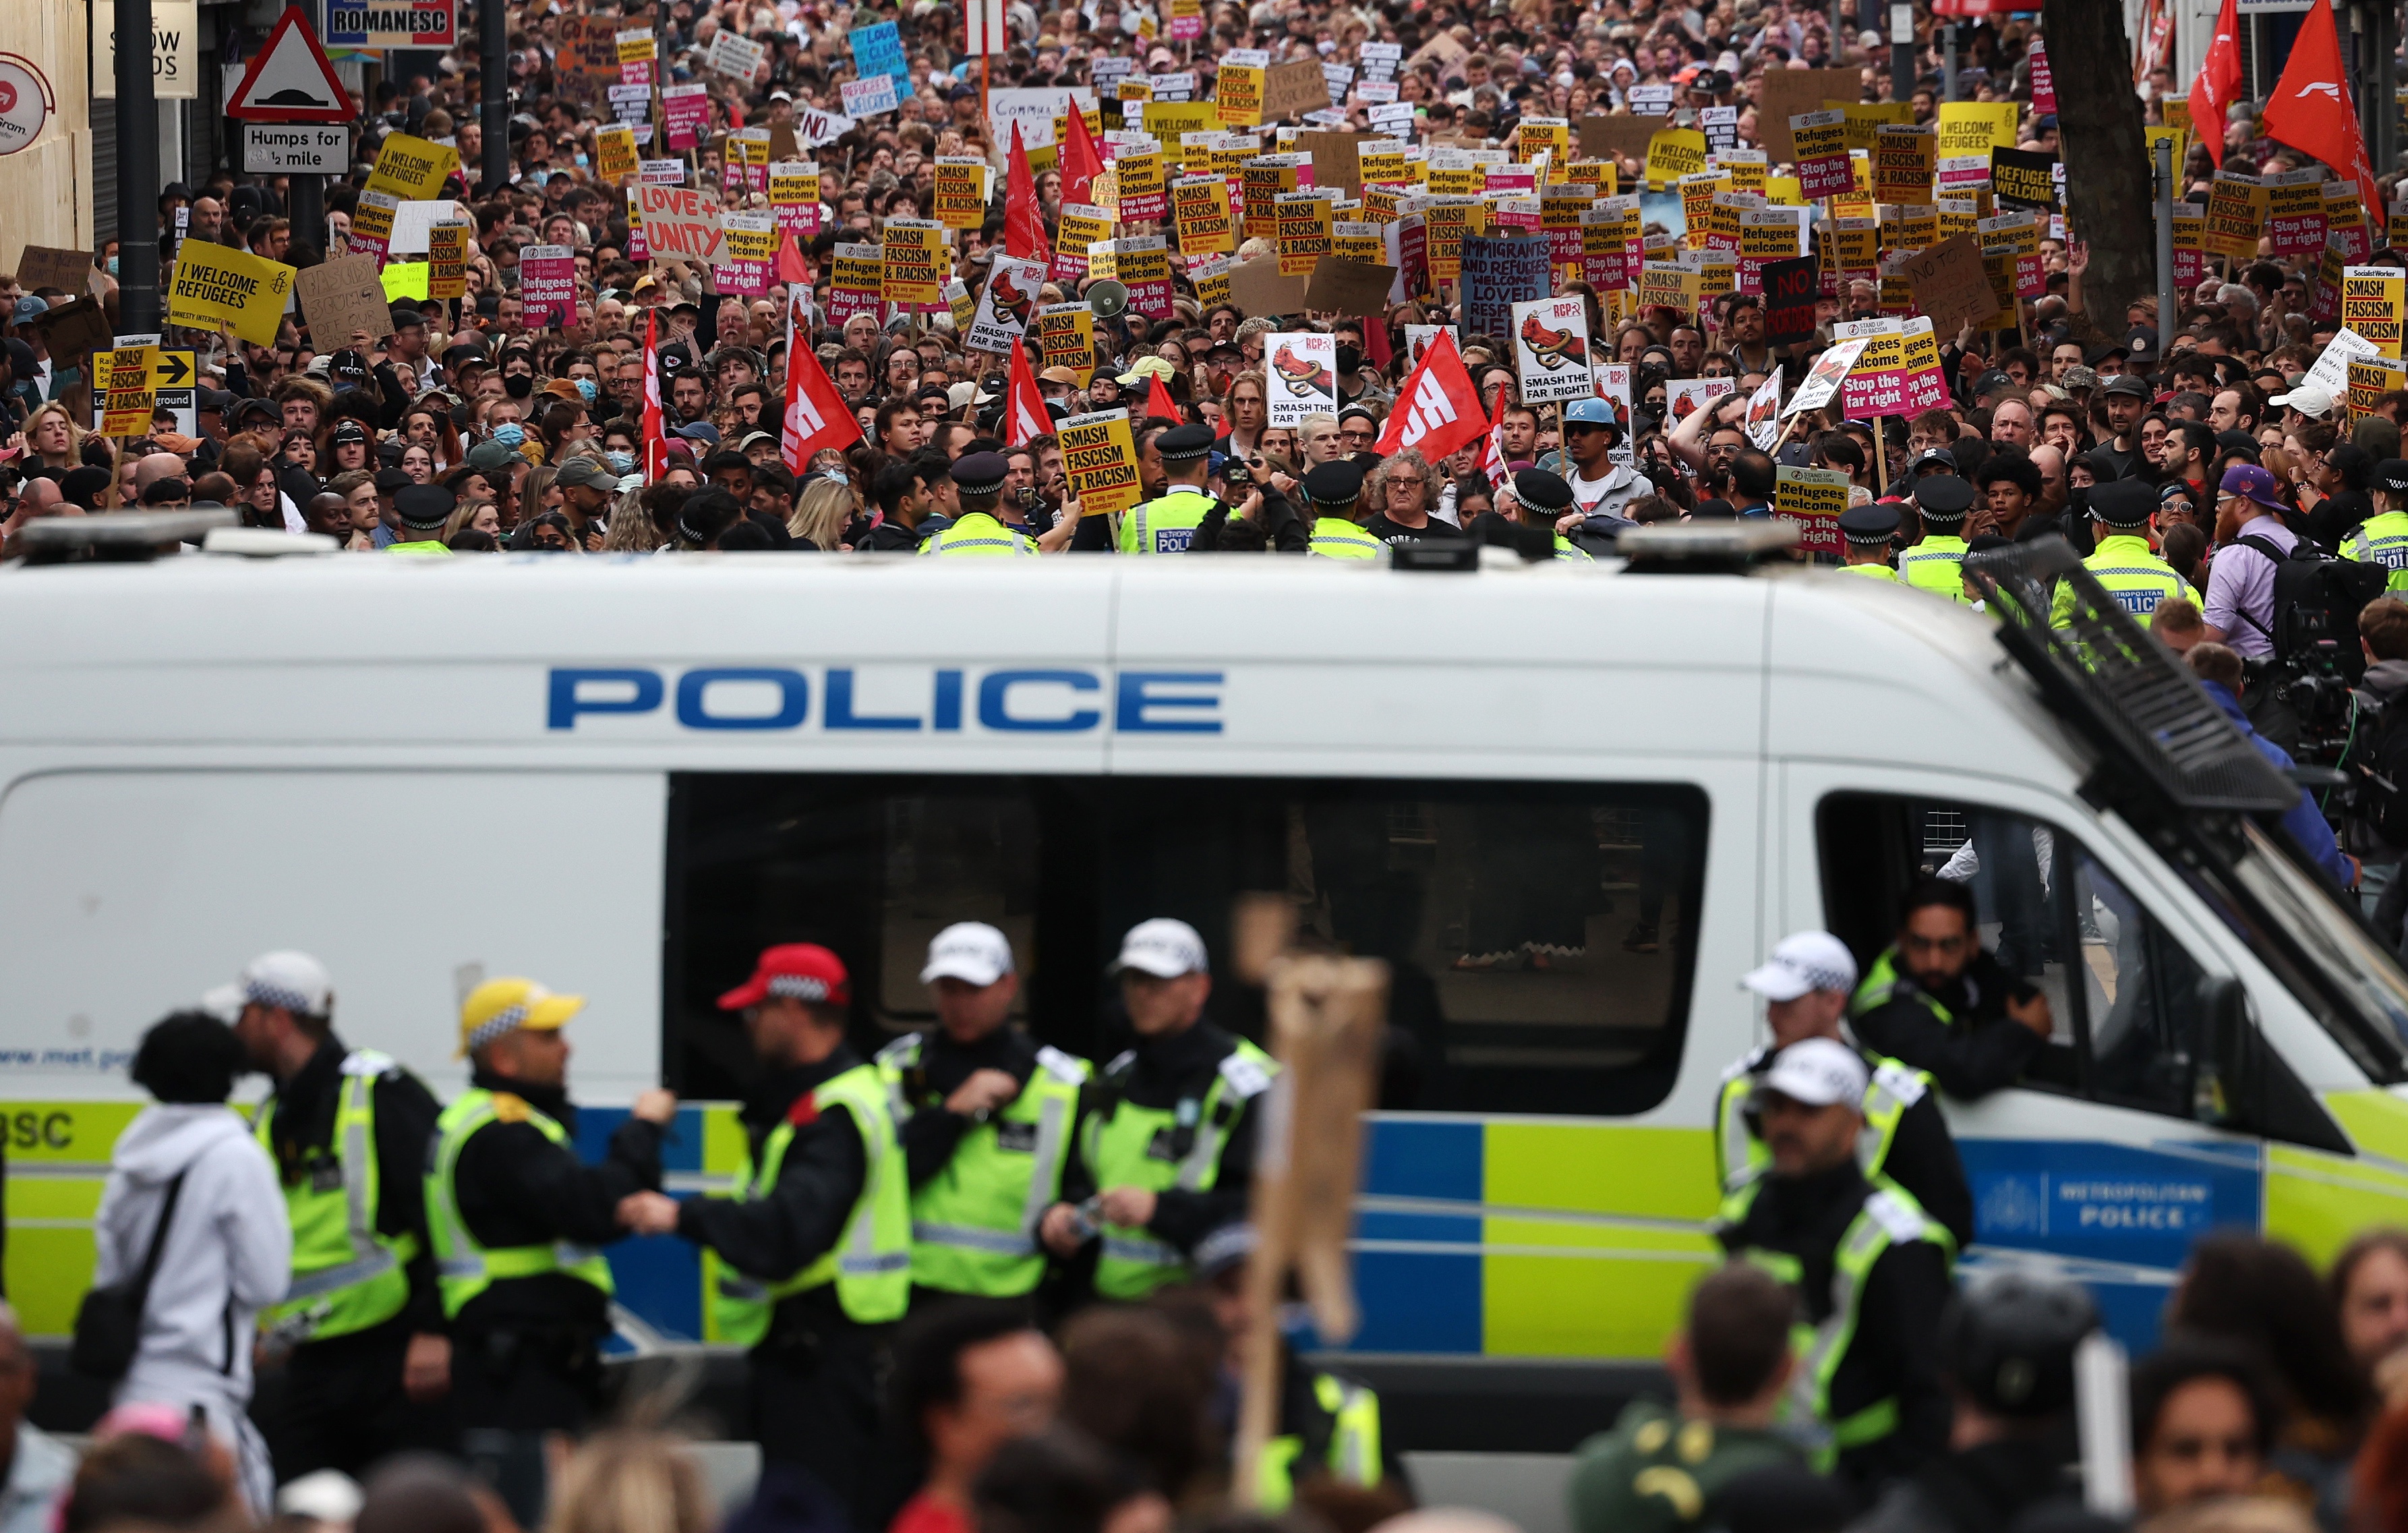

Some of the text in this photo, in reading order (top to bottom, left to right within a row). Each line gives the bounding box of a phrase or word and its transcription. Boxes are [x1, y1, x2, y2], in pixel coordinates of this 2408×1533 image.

[334, 9, 446, 33] ROMANESC
[842, 76, 889, 96] REFUGEES
[846, 94, 895, 115] WELCOME
[802, 114, 829, 140] NO
[1945, 122, 1995, 134] WELCOME
[251, 131, 341, 146] Humps for
[1795, 127, 1844, 143] Refugees
[1941, 136, 1989, 148] REFUGEES
[1798, 140, 1836, 156] welcome
[1879, 137, 1916, 150] SMASH
[287, 152, 322, 165] mile
[390, 152, 434, 173] WELCOME
[1118, 158, 1153, 171] Oppose
[1879, 154, 1925, 167] FASCISM
[377, 163, 426, 186] REFUGEES
[937, 167, 970, 179] SMASH
[1800, 159, 1844, 175] Stop the
[1119, 170, 1153, 183] Tommy
[1802, 173, 1847, 189] far right
[1889, 171, 1931, 184] RACISM
[1996, 165, 2052, 185] REFUGEE
[773, 178, 817, 190] Refugees
[937, 182, 976, 194] FASCISM
[1120, 181, 1163, 196] Robinson
[1996, 182, 2052, 201] WELCOM
[2214, 183, 2250, 200] SMASH
[773, 190, 815, 200] welcome
[1177, 186, 1210, 201] SMASH
[2270, 187, 2320, 200] Refugees
[641, 186, 696, 217] LOVE
[946, 197, 982, 209] RACISM
[2272, 200, 2319, 213] welcome
[357, 205, 393, 223] Refugees
[1178, 202, 1221, 219] FASCISM
[1278, 204, 1314, 219] SMASH
[2211, 200, 2256, 219] FASCISM
[354, 219, 388, 235] welcome
[1063, 216, 1100, 231] Oppose
[1190, 219, 1229, 233] RACISM
[1279, 222, 1324, 236] FASCISM
[2220, 219, 2259, 235] RACISM
[2274, 219, 2320, 233] Stop the
[431, 230, 457, 243] SMASH
[647, 221, 726, 258] UNITY
[886, 231, 924, 245] SMASH
[1061, 229, 1097, 243] Tommy
[1584, 227, 1623, 239] Refugees
[1743, 227, 1796, 241] Refugees
[2276, 231, 2322, 245] far right
[430, 246, 462, 261] FASCISM
[1291, 238, 1331, 254] RACISM
[1463, 236, 1550, 258] IMMIGRANTS
[1744, 241, 1794, 253] welcome
[885, 249, 931, 263] FASCISM
[1117, 253, 1166, 266] Refugees
[438, 262, 465, 277] RACISM
[895, 266, 937, 281] RACISM
[1119, 266, 1164, 280] welcome
[1462, 258, 1549, 276] AND REFUGEES
[1912, 260, 1935, 278] NO
[190, 264, 259, 295] WELCOME
[523, 278, 572, 290] Refugees
[716, 274, 761, 288] far right
[1644, 273, 1682, 288] SMASH
[1778, 269, 1809, 295] NO
[176, 280, 247, 309] REFUGEES
[1473, 286, 1537, 301] LOVED
[2347, 280, 2384, 296] SMASH
[523, 291, 570, 301] welcome
[832, 291, 880, 304] Stop the
[523, 303, 548, 314] here
[831, 304, 847, 316] far
[1139, 297, 1166, 312] right
[2347, 301, 2393, 318] FASCISM
[171, 310, 236, 330] AMNESTY INTERNATNAL
[316, 310, 374, 335] OFF OUR
[1043, 316, 1074, 331] SMASH
[1766, 302, 1815, 335] BORDERS
[974, 325, 1003, 337] SMASH
[2357, 323, 2399, 339] RACISM
[970, 335, 989, 347] FAR
[1044, 333, 1084, 349] FASCISM
[2339, 332, 2370, 353] REFUGEES
[114, 349, 144, 367] SMASH
[1053, 351, 1092, 366] RACISM
[2330, 346, 2344, 357] ARE
[2320, 355, 2342, 372] HUMAN
[2355, 356, 2399, 369] Socialist Worker
[110, 371, 146, 388] FASCISM
[1525, 374, 1589, 388] SMASH THE
[2312, 366, 2338, 385] BEINGS
[2349, 371, 2386, 388] SMASH
[1527, 384, 1590, 398] FAR RIGHT!
[1844, 374, 1900, 393] Stop the
[107, 391, 152, 411] & RACISM
[1846, 391, 1902, 409] far right
[1273, 403, 1333, 413] SMASH THE
[1067, 413, 1117, 428] Socialist Worker
[1273, 413, 1294, 423] FAR
[1062, 426, 1110, 448] SMASH
[1067, 445, 1124, 469] FASCISM
[1609, 453, 1631, 462] RIGHT!
[1087, 465, 1137, 488] RACISM
[1087, 492, 1125, 505] By any means
[1780, 483, 1845, 500] Refugees
[1088, 500, 1117, 510] necessary
[1780, 498, 1841, 513] welcome
[1816, 517, 1838, 529] the
[1802, 531, 1837, 545] right
[548, 667, 1225, 733] POLICE
[2080, 1207, 2185, 1227] POLICE
